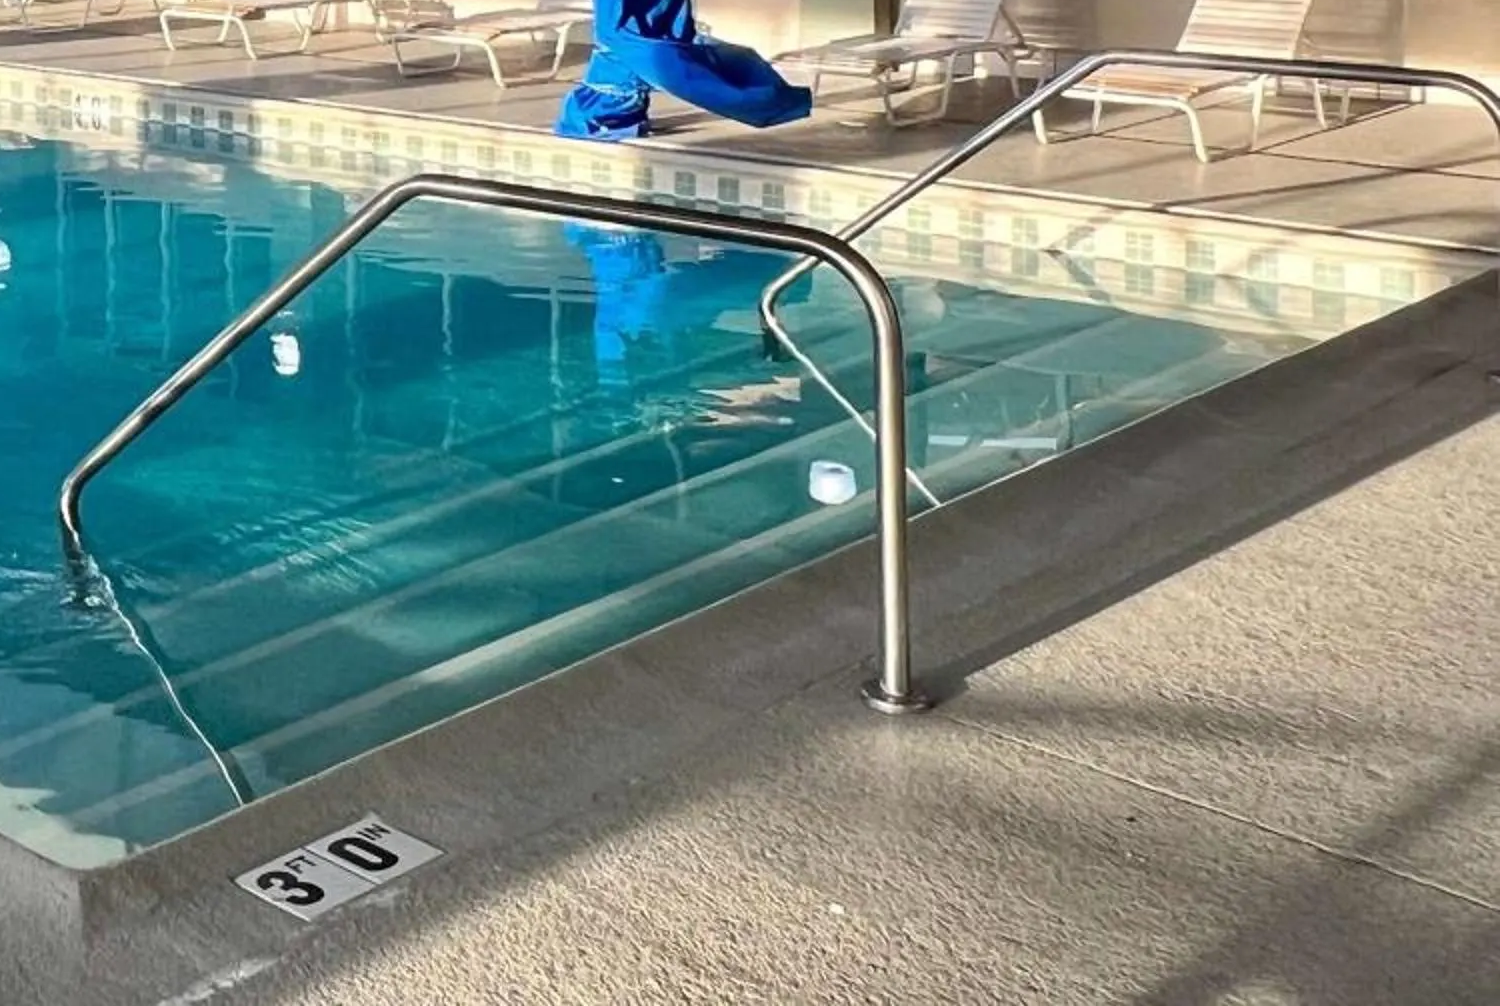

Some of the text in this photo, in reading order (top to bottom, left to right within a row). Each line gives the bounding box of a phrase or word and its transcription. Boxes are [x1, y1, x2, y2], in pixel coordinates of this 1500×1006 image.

[256, 823, 400, 906] 3 FT 0 IN
